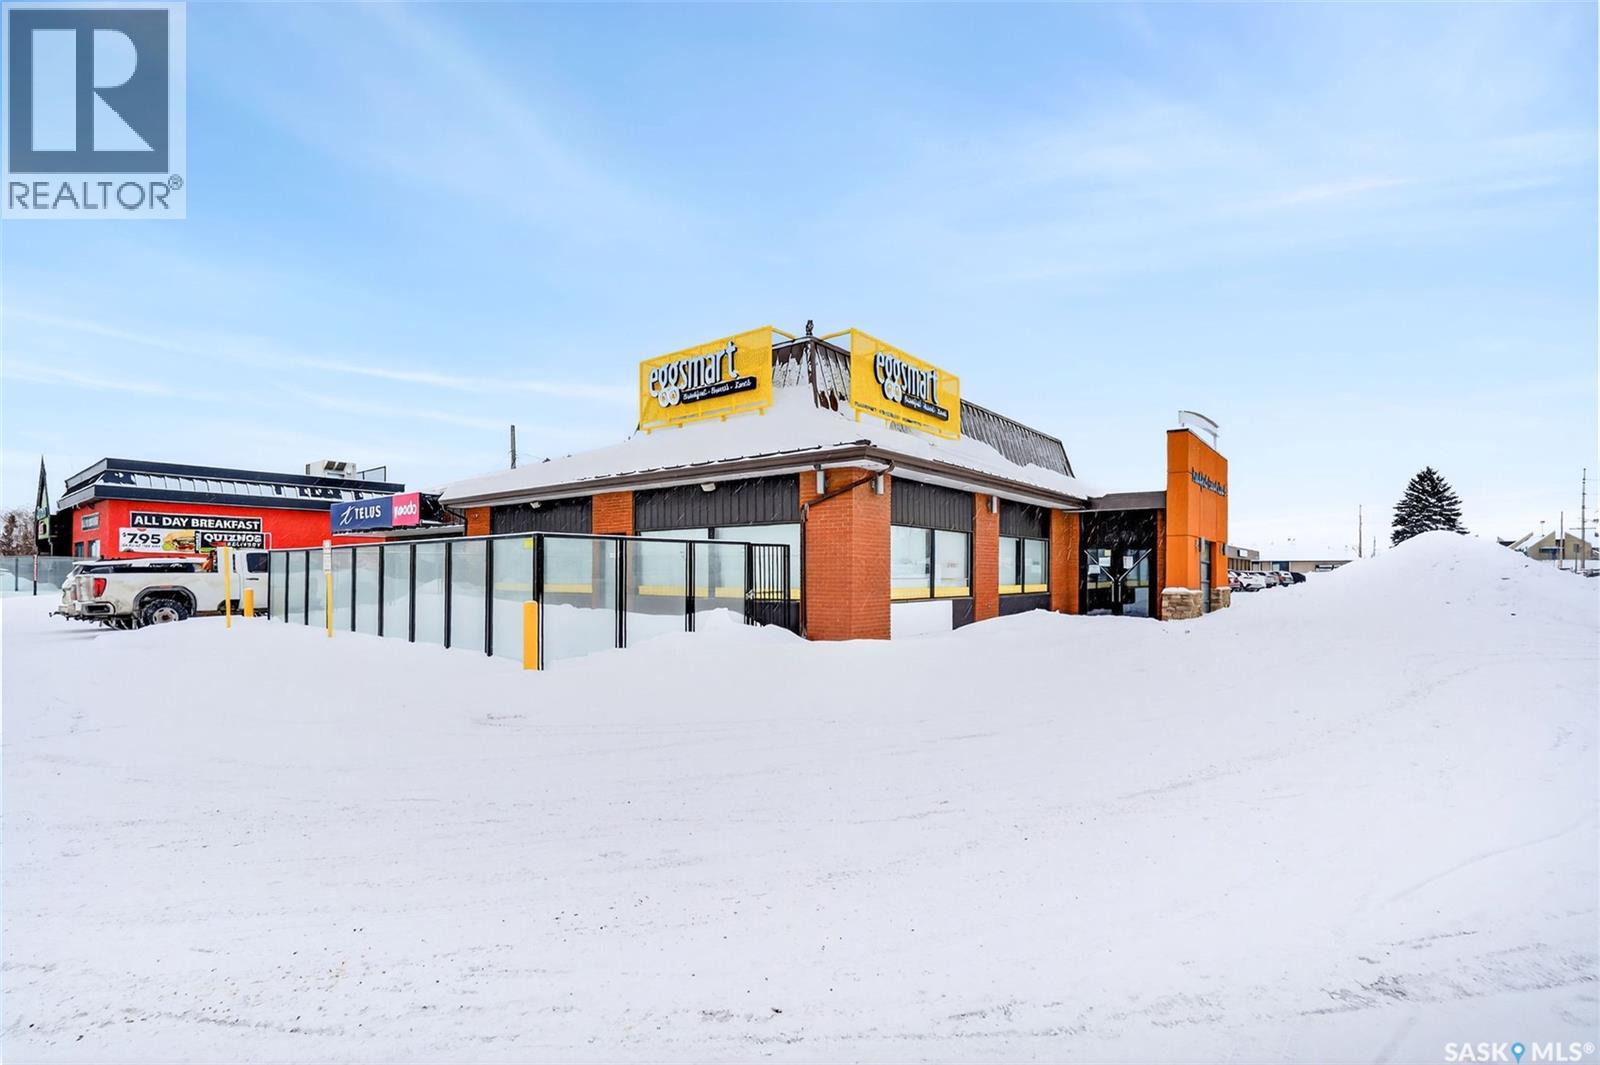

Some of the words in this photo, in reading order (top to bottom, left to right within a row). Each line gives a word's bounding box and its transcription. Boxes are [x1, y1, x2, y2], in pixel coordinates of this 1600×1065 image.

[649, 341, 738, 407] eggsmart
[874, 352, 939, 404] eggsmart
[355, 505, 382, 519] TELUS
[134, 515, 159, 526] ALL
[162, 516, 188, 527] DAY
[191, 518, 260, 530] BREAKFAST
[204, 533, 262, 543] QUIZNOS
